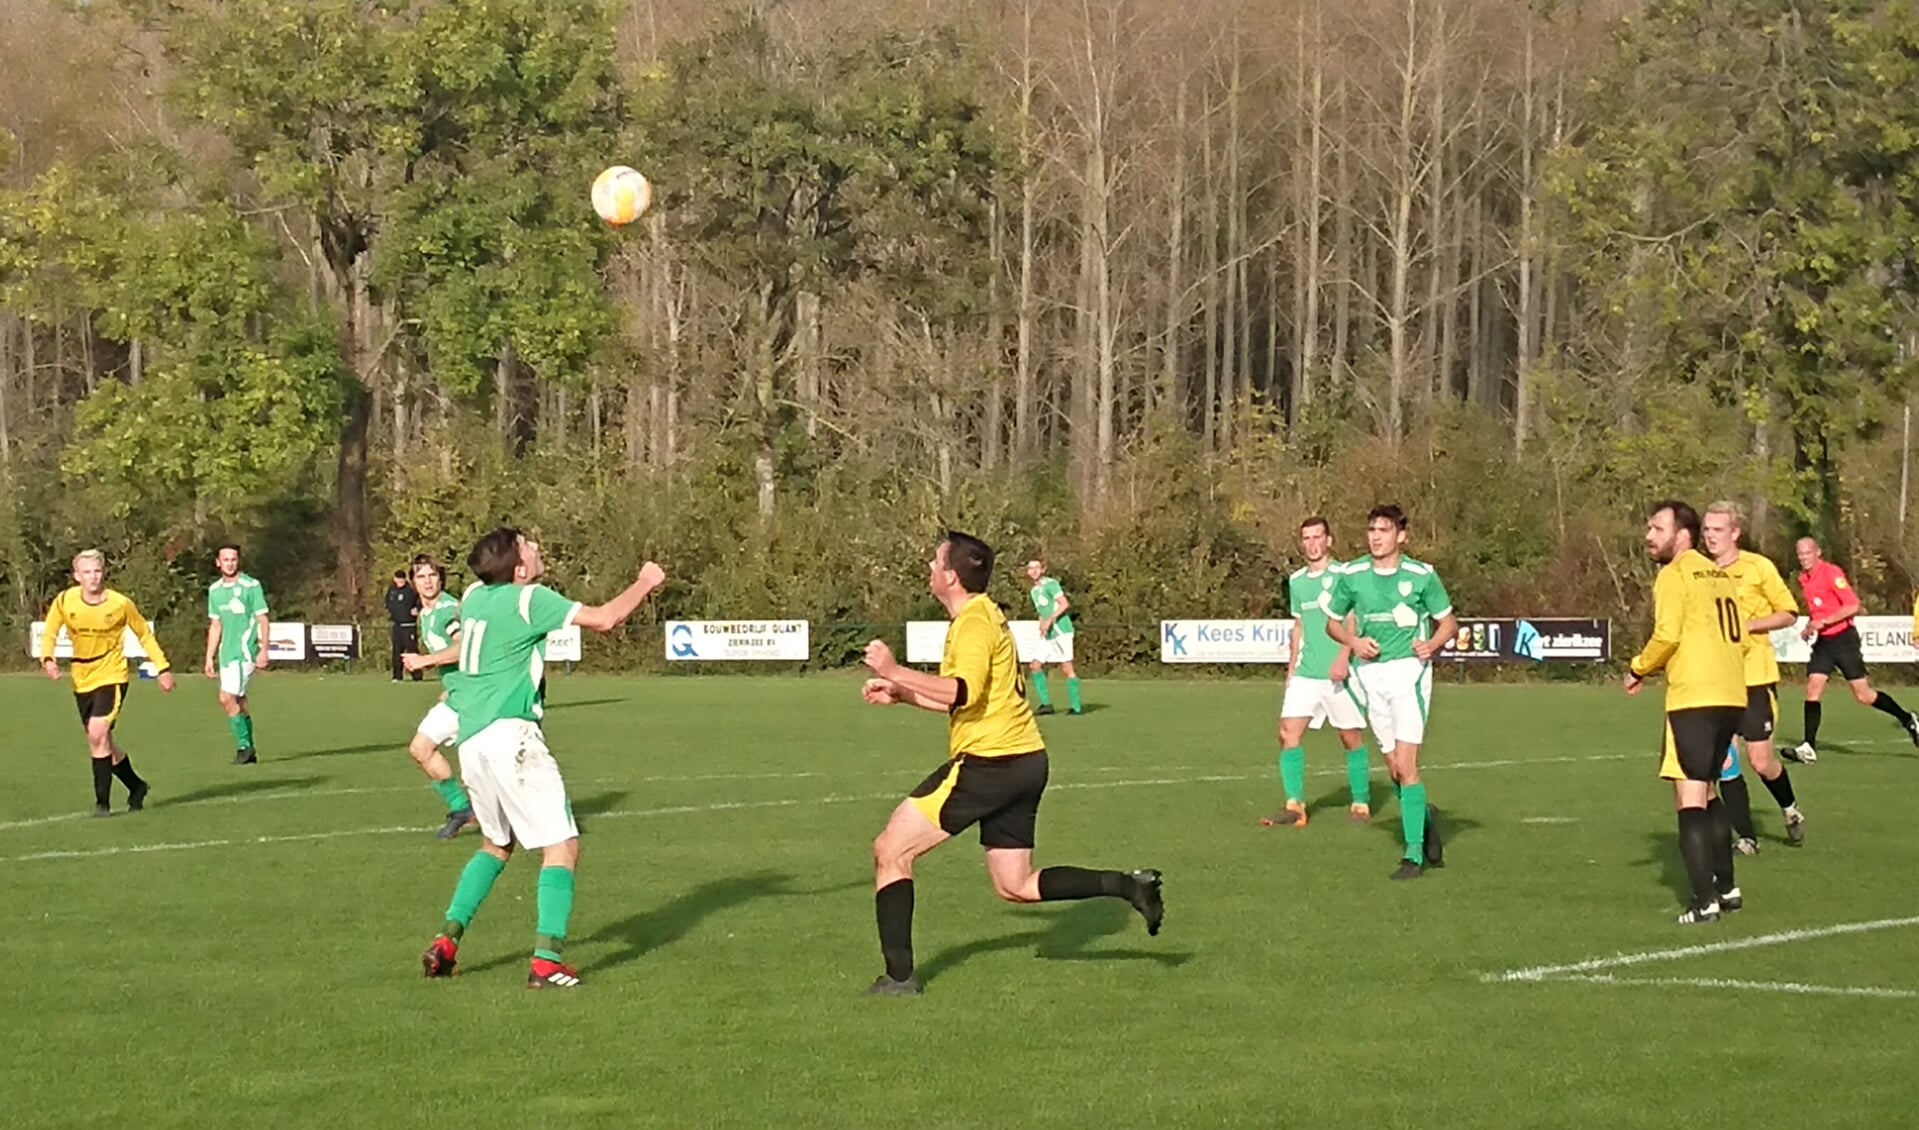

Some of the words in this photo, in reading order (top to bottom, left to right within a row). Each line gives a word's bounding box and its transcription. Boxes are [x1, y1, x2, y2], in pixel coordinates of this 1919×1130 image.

[703, 624, 767, 634] BOUWBEDRIJF
[772, 624, 802, 634] QUANT
[1198, 625, 1245, 642] Kees
[1715, 597, 1741, 643] 10
[459, 617, 487, 675] 11
[672, 624, 699, 657] Q
